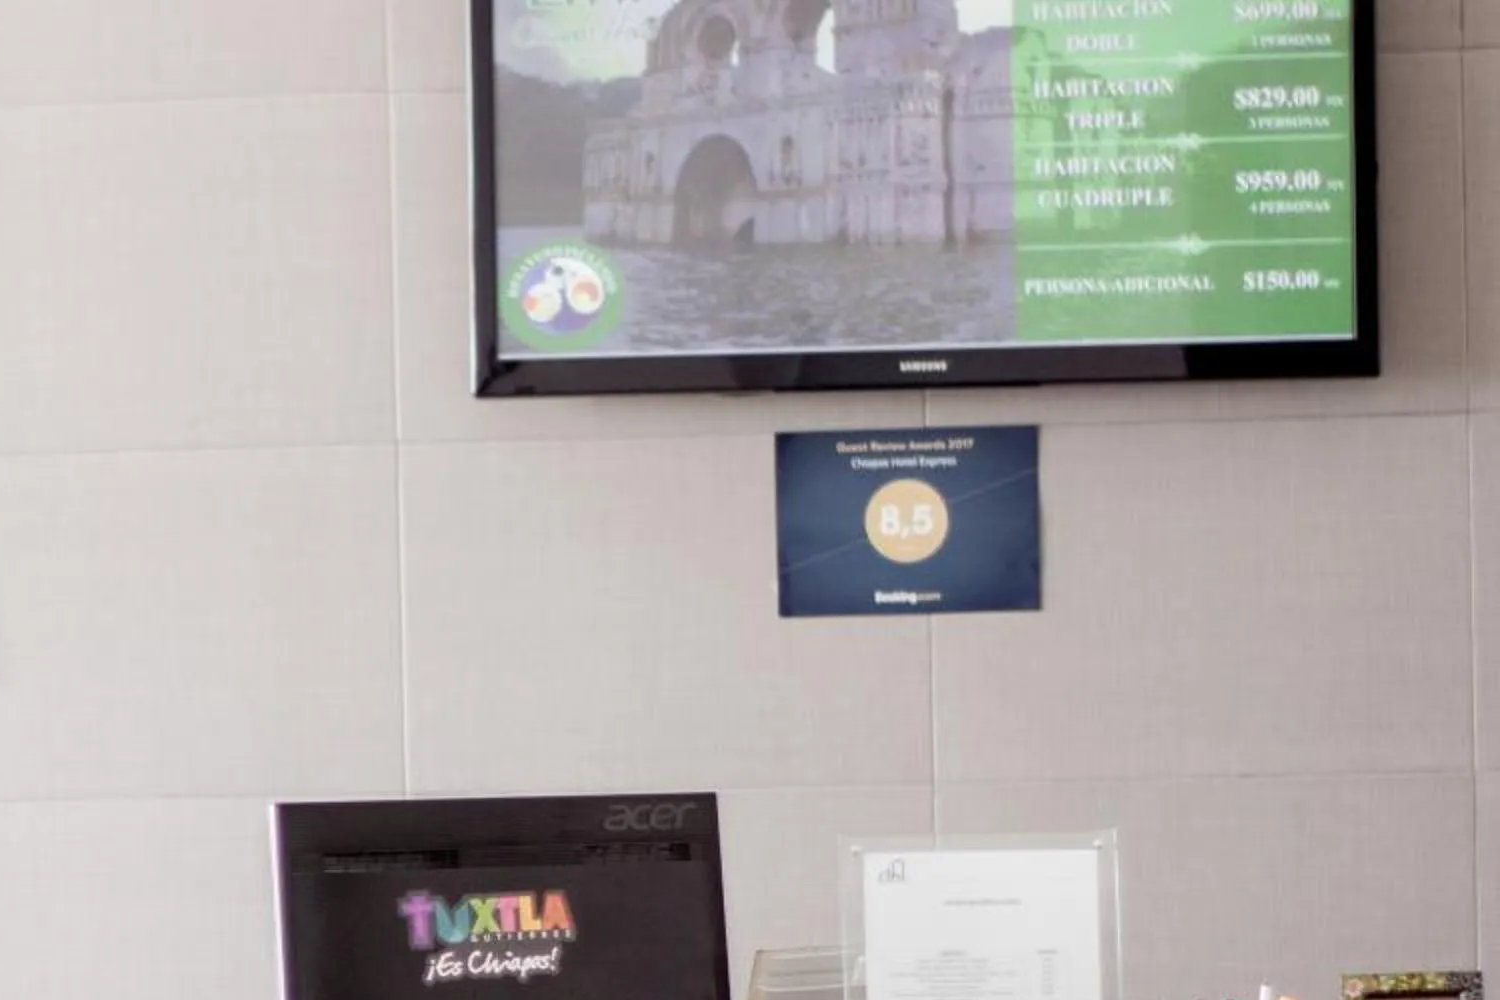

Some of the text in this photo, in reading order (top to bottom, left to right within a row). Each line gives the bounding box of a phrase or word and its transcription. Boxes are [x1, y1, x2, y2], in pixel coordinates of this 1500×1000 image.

[1233, 85, 1320, 110] $829.00
[1065, 110, 1146, 130] TRIPLE
[1235, 169, 1320, 193] $959.00
[1036, 186, 1176, 209] CUADRUPLE
[1242, 270, 1320, 292] $150.00
[602, 802, 698, 832] acer
[399, 891, 575, 950] TUXTLA
